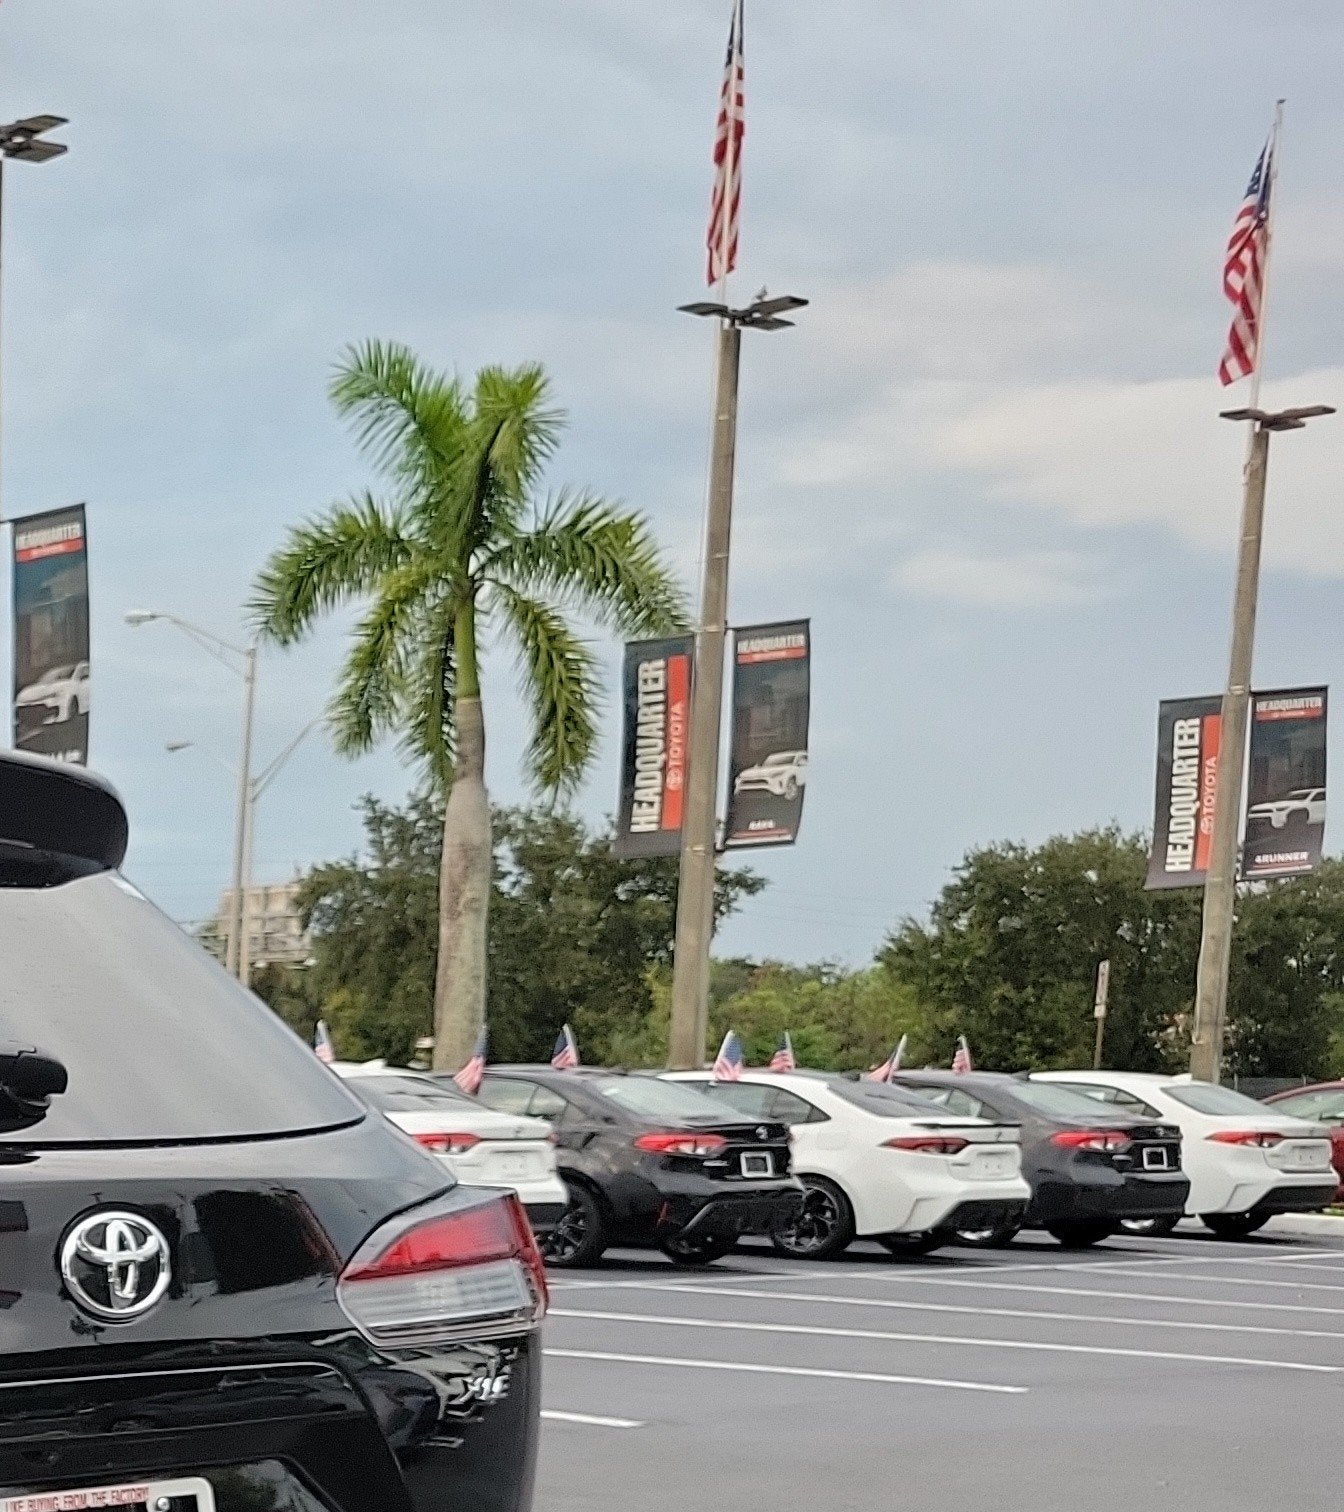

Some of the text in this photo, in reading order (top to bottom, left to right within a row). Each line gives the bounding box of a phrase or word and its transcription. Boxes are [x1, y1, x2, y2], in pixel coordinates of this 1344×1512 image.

[630, 658, 666, 833] HEADQUARTER
[669, 702, 686, 766] TOYOTA
[1164, 717, 1200, 873] HEADQUARTER
[1201, 756, 1217, 819] TOYOTA
[1254, 851, 1309, 864] 4RUNNER
[63, 1493, 87, 1509] FROM
[91, 1491, 107, 1506] THE
